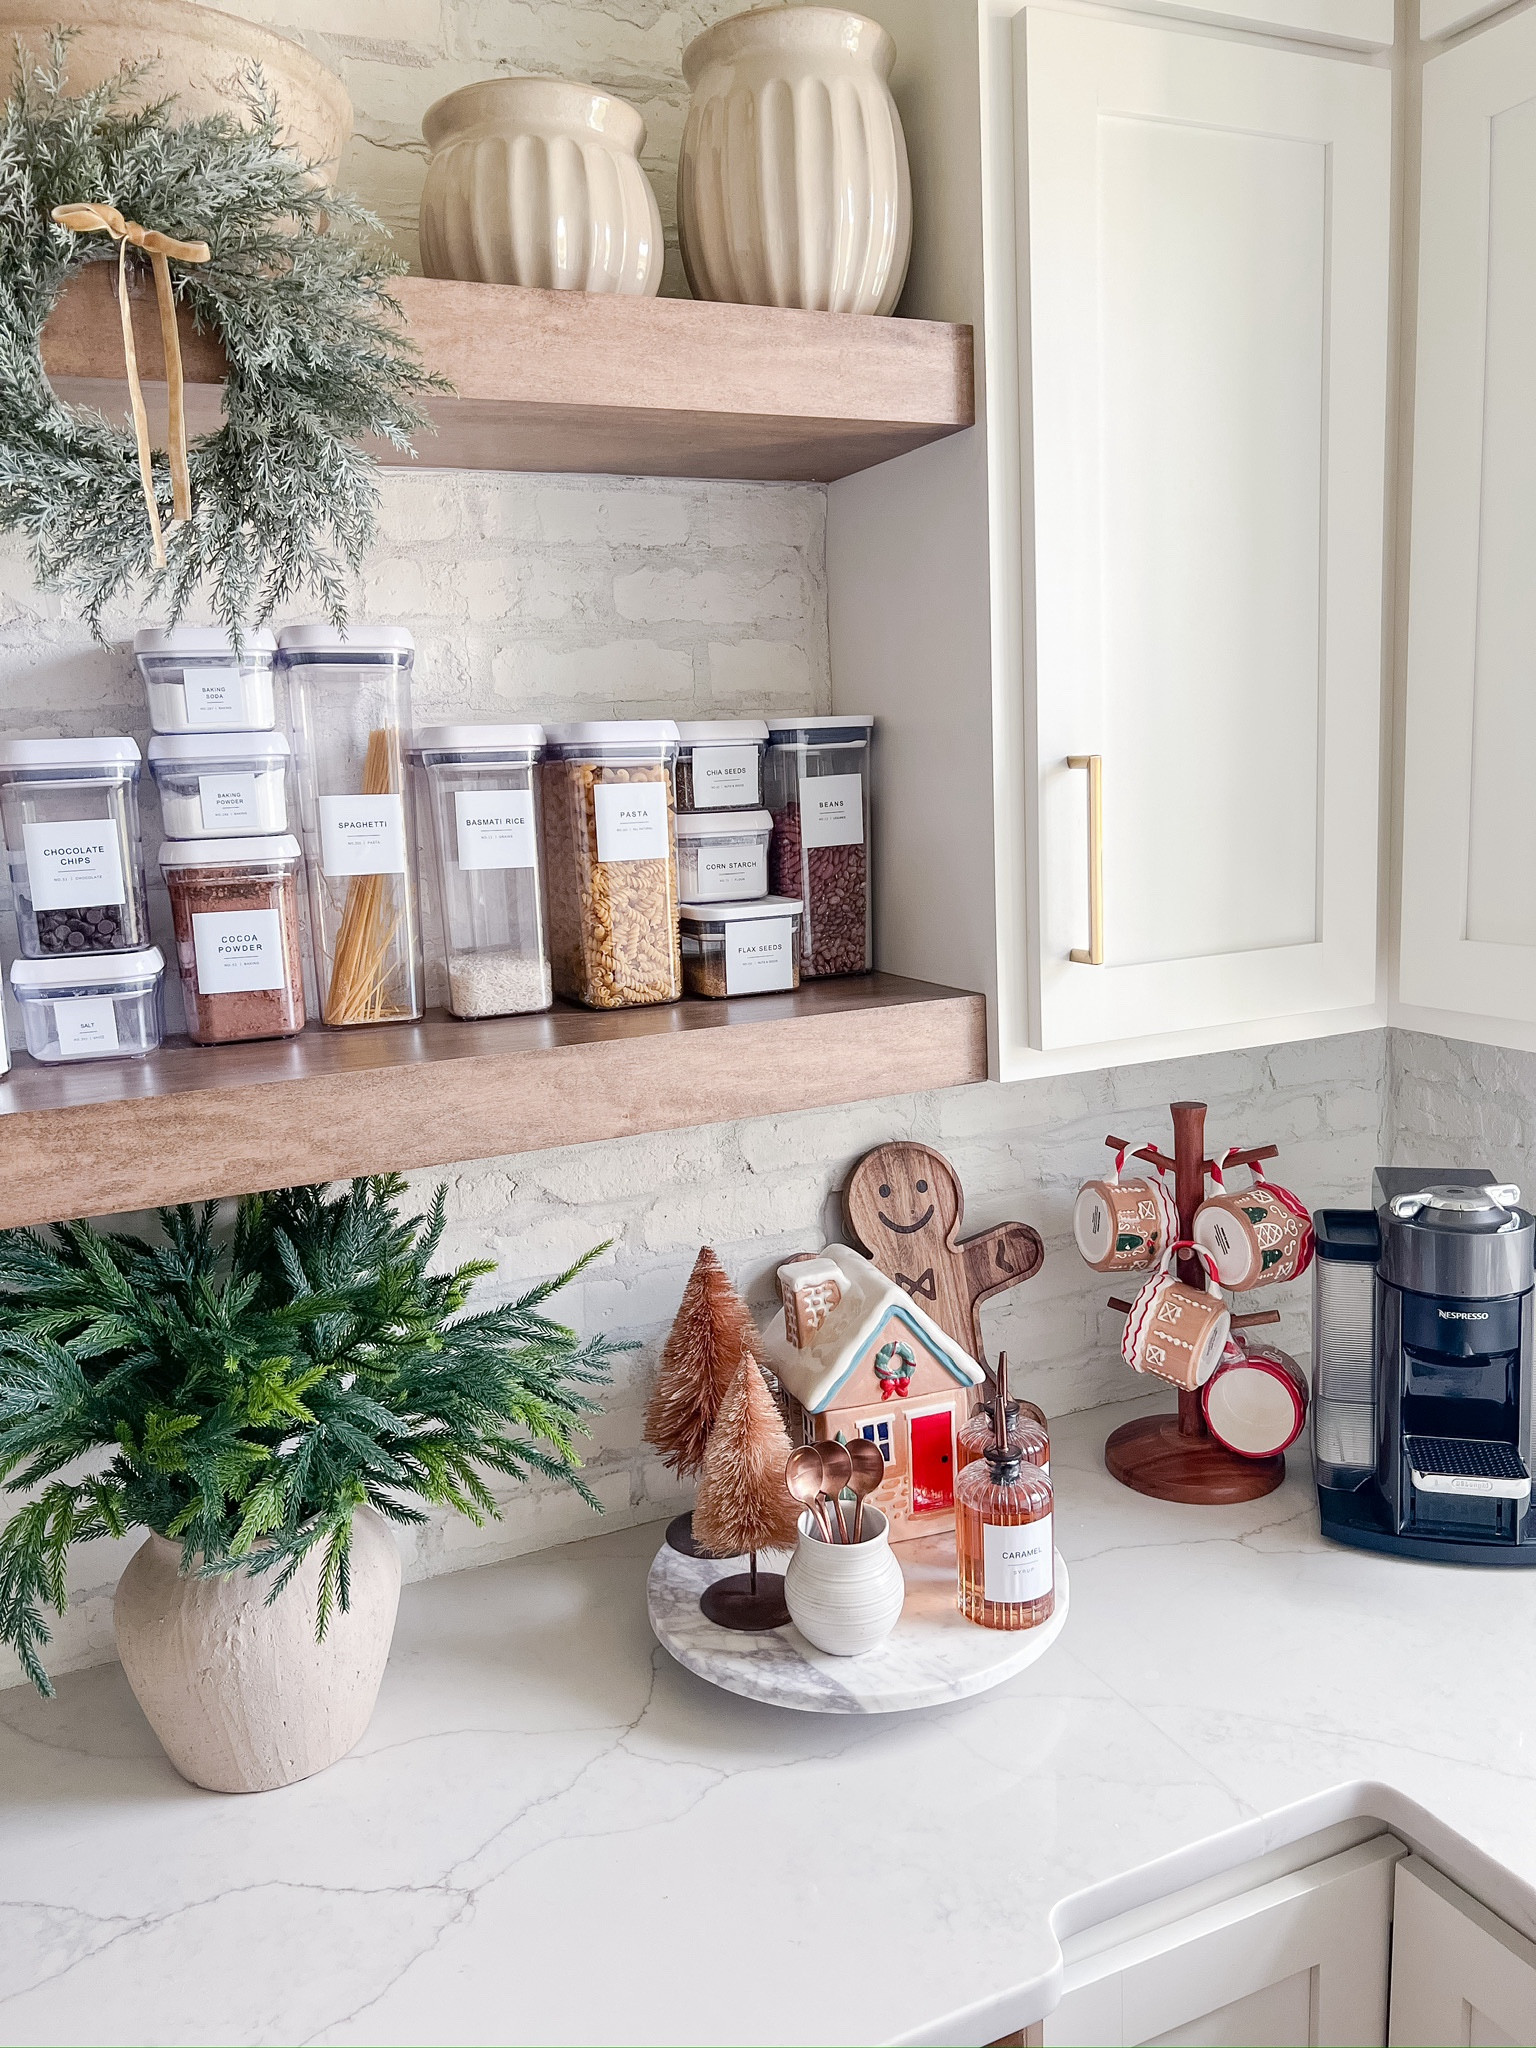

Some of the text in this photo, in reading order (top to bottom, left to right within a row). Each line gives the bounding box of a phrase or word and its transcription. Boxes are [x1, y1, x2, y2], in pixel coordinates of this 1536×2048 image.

[724, 767, 747, 775] SEEDS
[819, 800, 844, 808] BEANS
[620, 810, 648, 818] PASTA
[338, 820, 387, 829] SPAGHETTI
[466, 817, 525, 826] BASMATI RICE
[43, 845, 105, 857] CHOCOLATE
[60, 856, 91, 866] CHIPS
[705, 861, 757, 871] CORN STARCH
[221, 934, 258, 944] COCOA
[218, 943, 263, 953] POWDER
[758, 943, 783, 952] SEEDS
[1436, 1308, 1489, 1320] NESPRESSO
[1002, 1547, 1042, 1560] CARAMEL
